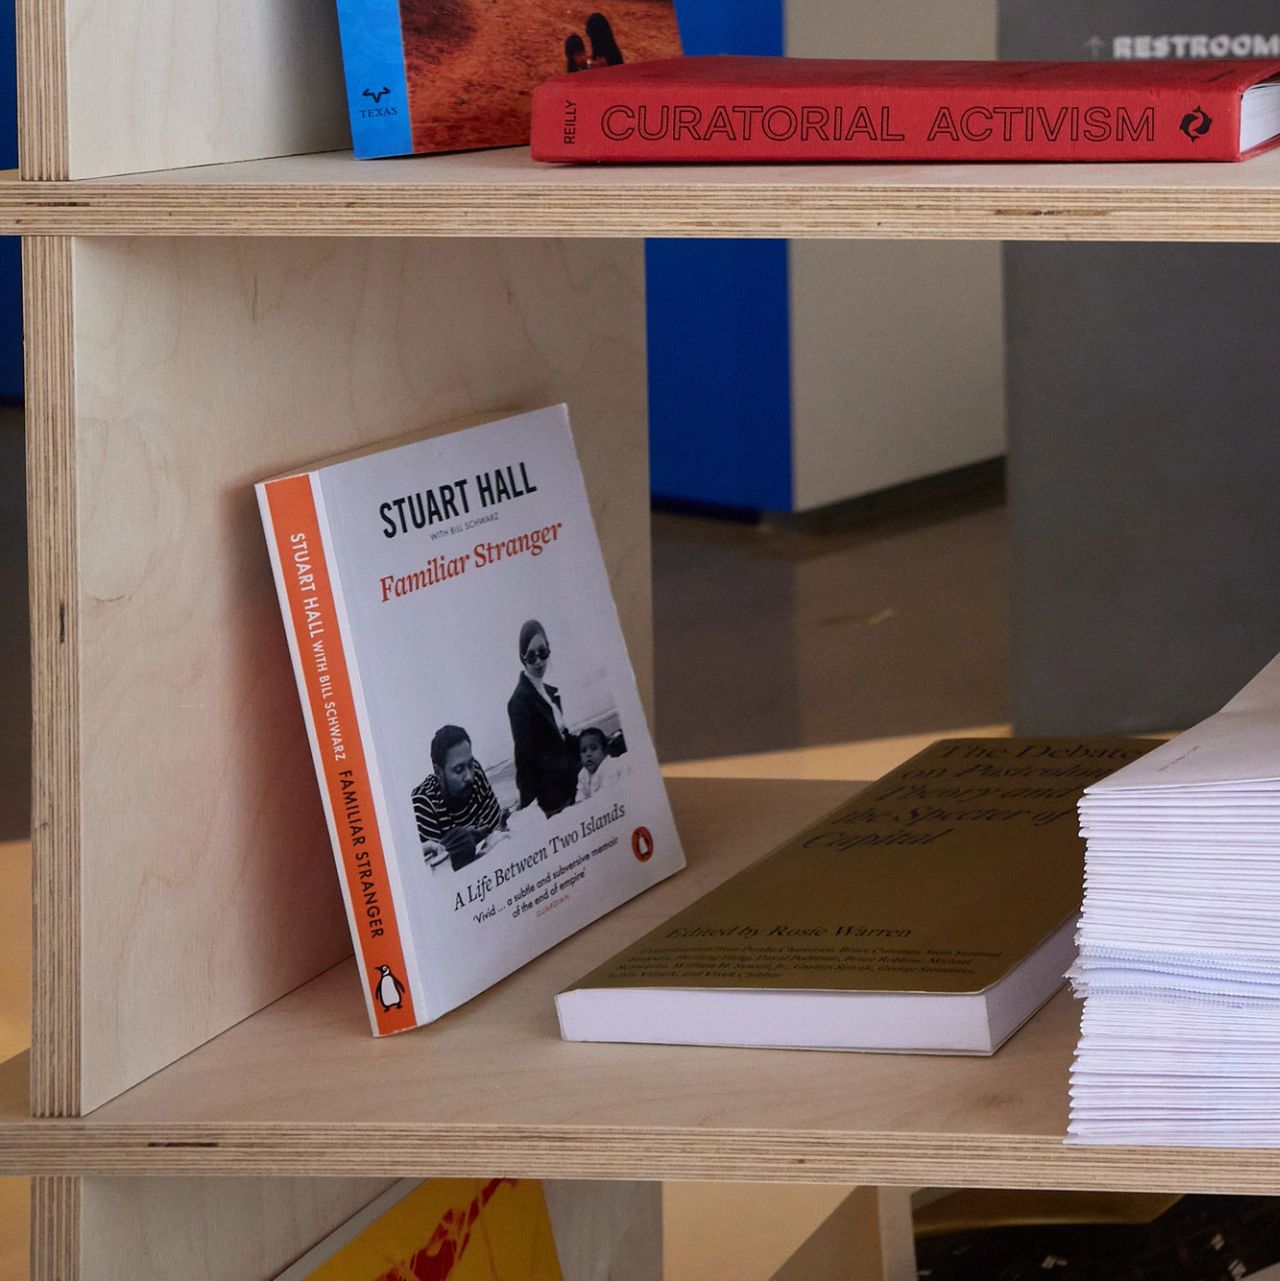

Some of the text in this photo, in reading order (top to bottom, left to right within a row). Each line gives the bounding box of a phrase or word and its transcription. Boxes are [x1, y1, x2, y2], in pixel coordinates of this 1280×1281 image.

[359, 107, 398, 120] TEXAS
[563, 99, 577, 145] REILLY
[601, 104, 1155, 142] CURATORIAL ACTIVISM
[379, 462, 537, 539] STUART HALL
[429, 512, 499, 541] WITH BILL SCHWARZ
[380, 522, 562, 603] Familiar Stranger
[290, 532, 347, 762] STUART HALL WITH BILL SCHWARZ
[338, 769, 385, 940] FAMILIAR STRANGER
[454, 803, 626, 912] A Life Between Two Islands
[513, 883, 535, 902] subtle
[536, 875, 551, 889] and
[552, 854, 590, 878] subversive
[591, 837, 619, 857] memoir
[512, 907, 523, 918] of
[521, 899, 534, 913] the
[534, 891, 549, 905] end
[550, 883, 559, 896] of
